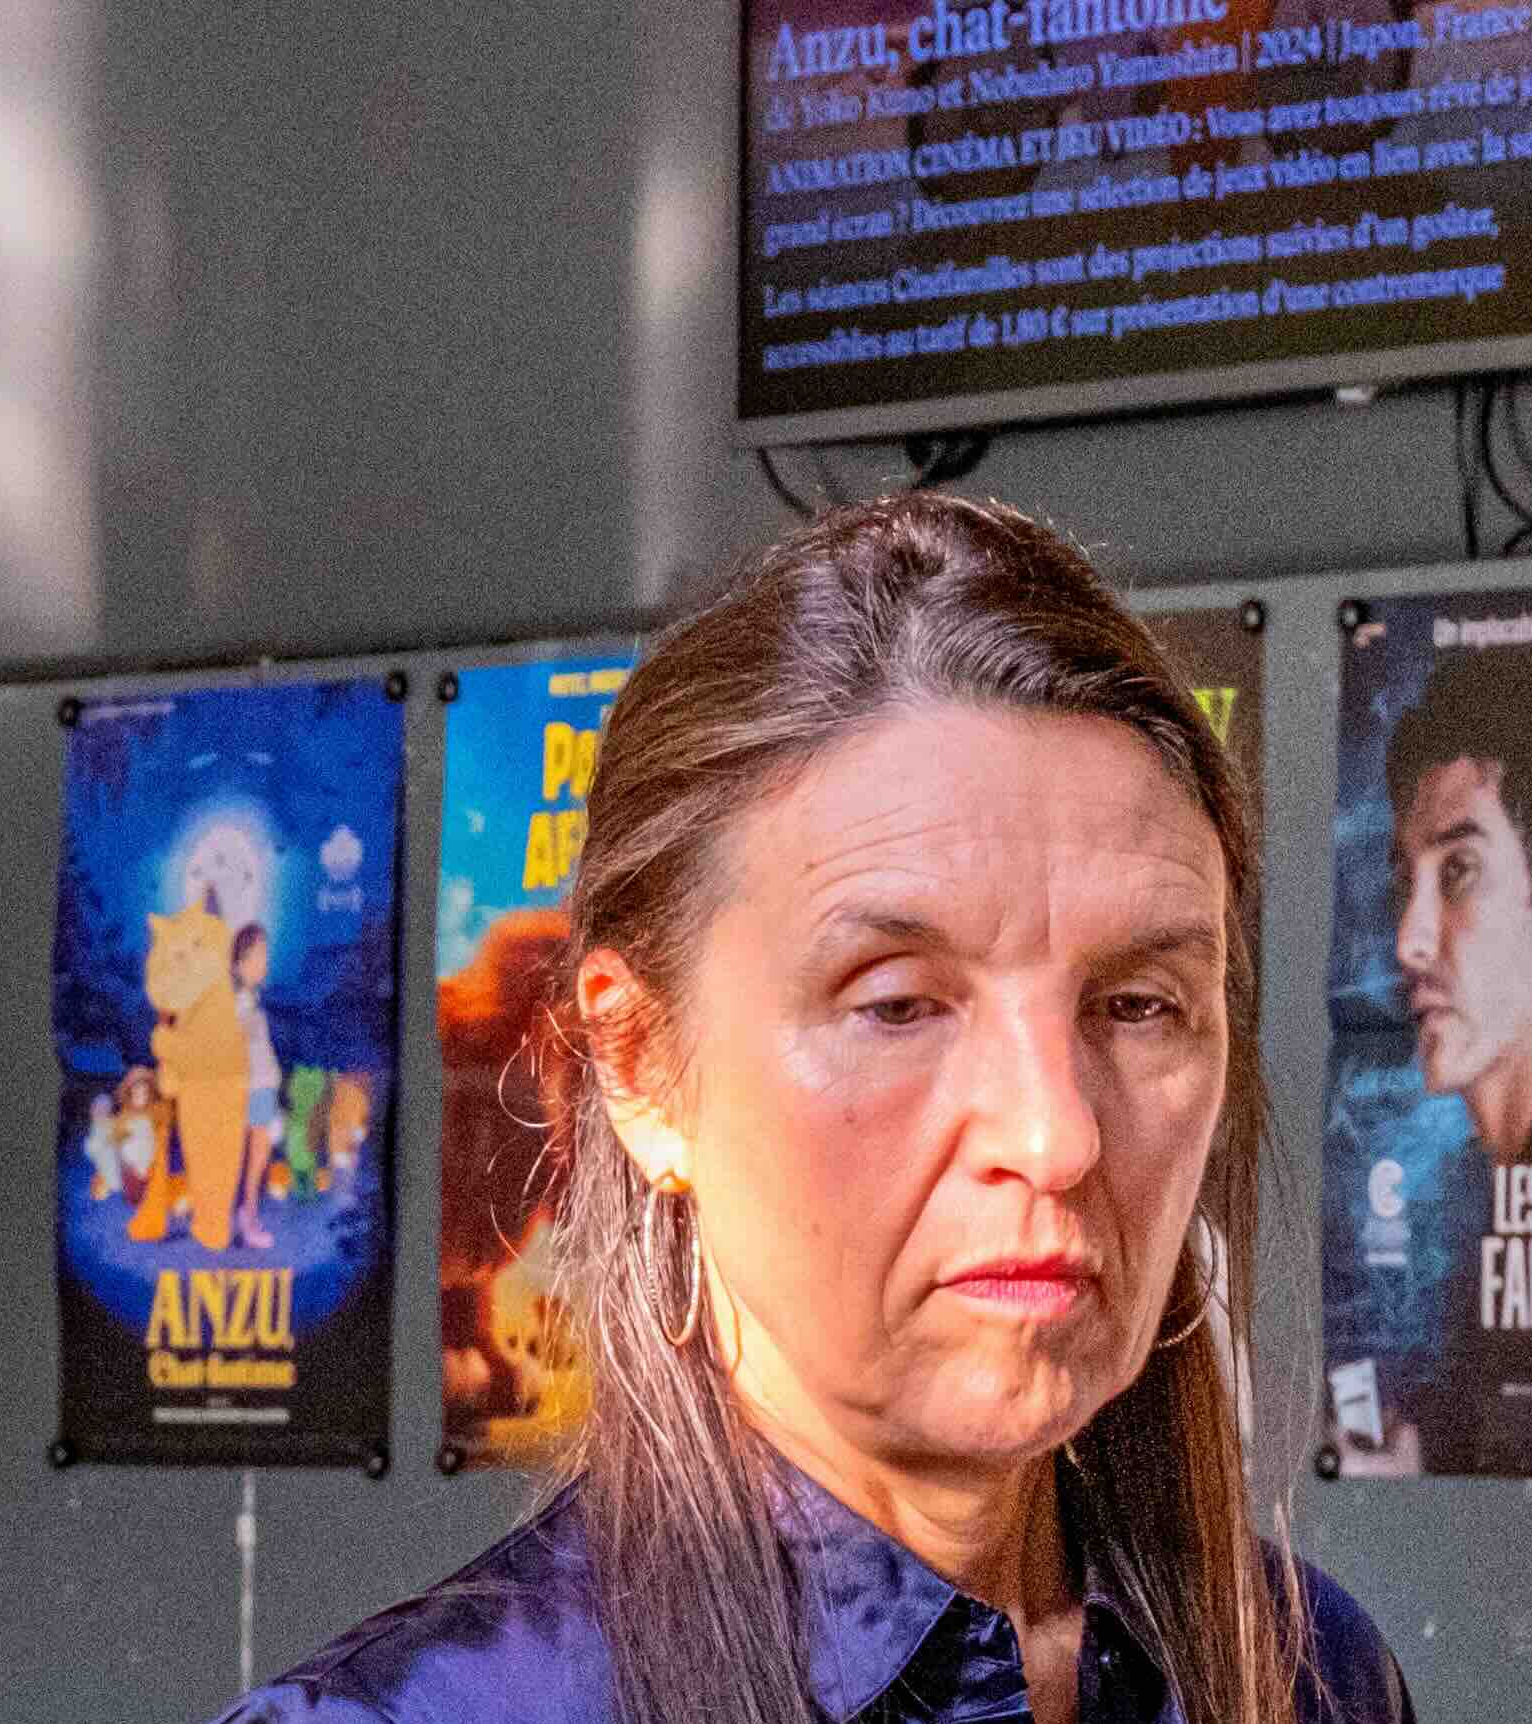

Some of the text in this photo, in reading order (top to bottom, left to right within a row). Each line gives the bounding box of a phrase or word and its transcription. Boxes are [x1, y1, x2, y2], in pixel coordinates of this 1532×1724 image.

[769, 22, 899, 81] Anzu,
[1257, 28, 1323, 66] 2024
[146, 1267, 295, 1350] ANZU
